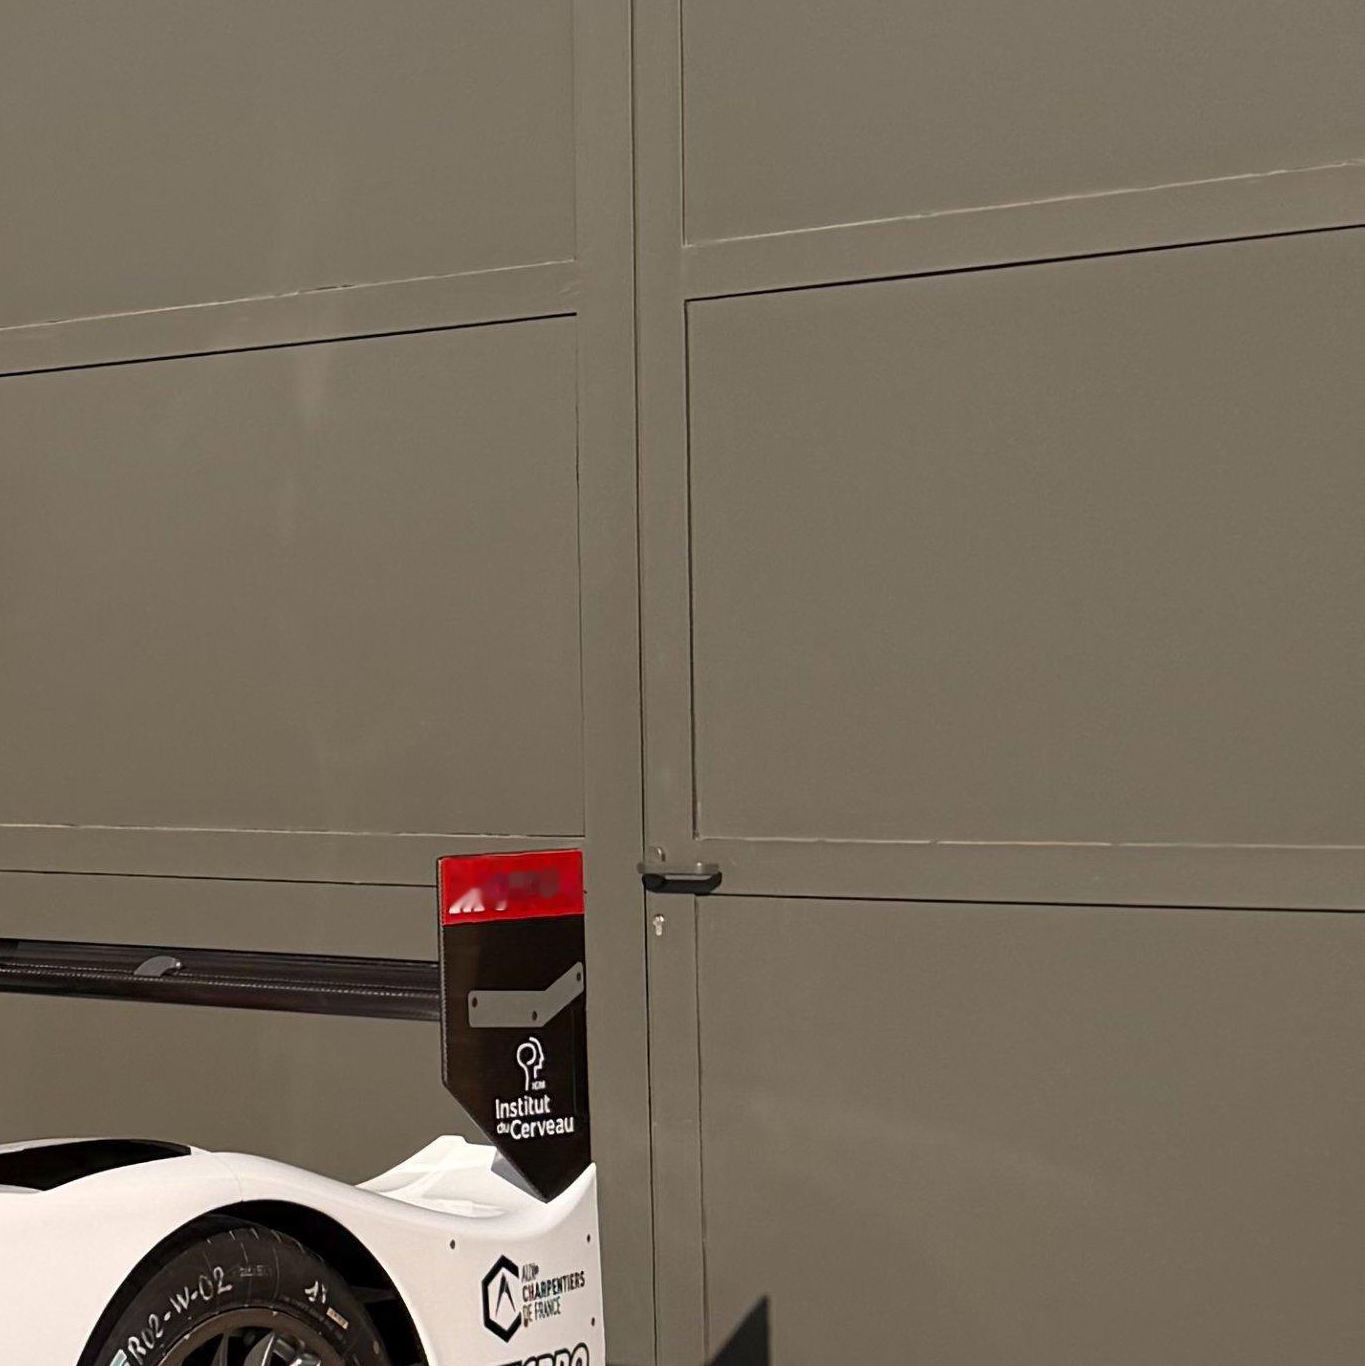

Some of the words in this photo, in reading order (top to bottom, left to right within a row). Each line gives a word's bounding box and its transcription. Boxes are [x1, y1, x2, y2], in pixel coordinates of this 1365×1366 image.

[495, 1095, 551, 1120] Institut
[496, 1122, 510, 1134] du
[510, 1116, 575, 1140] Cerveau
[522, 1271, 586, 1303] CHARPENTIERS
[522, 1304, 533, 1323] DE
[534, 1296, 562, 1321] FRANCE
